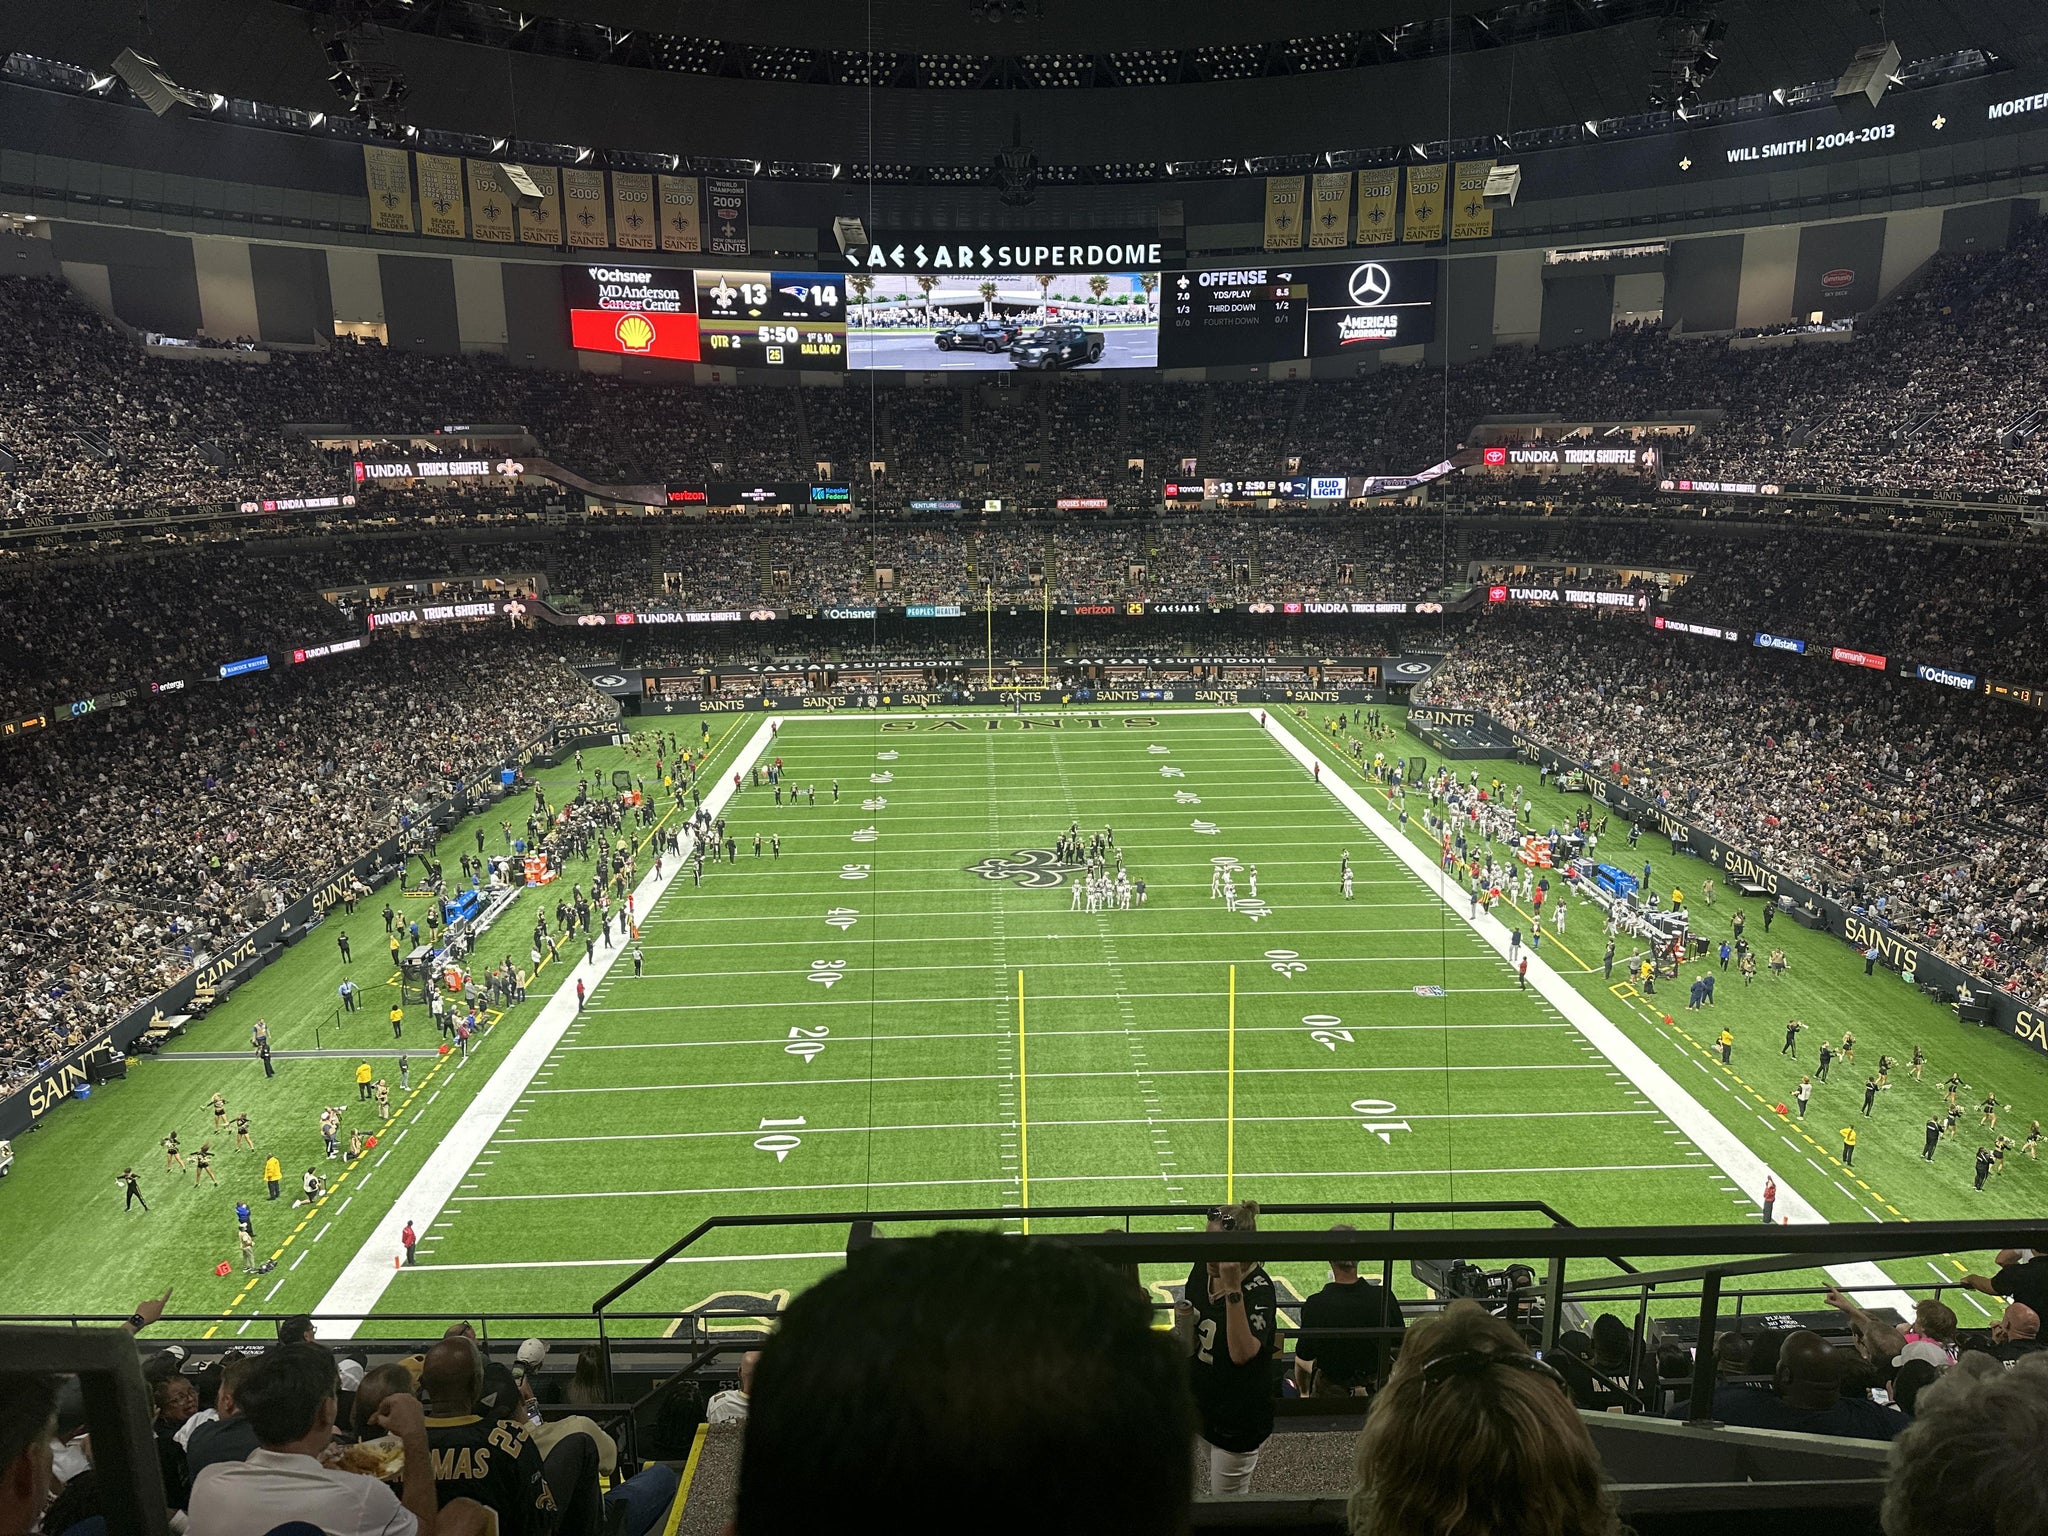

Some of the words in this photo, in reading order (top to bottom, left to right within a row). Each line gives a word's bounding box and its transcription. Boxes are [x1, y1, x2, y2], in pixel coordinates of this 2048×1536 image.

[1728, 146, 1760, 163] WILL
[1762, 138, 1807, 158] SMITH
[1816, 123, 1896, 150] 2004-2013
[709, 186, 744, 194] CHAMPIONS
[1412, 183, 1439, 194] 2019
[1460, 179, 1486, 190] 2020
[570, 188, 600, 200] 2006
[618, 190, 648, 202] 2009
[1319, 190, 1344, 201] 2017
[1365, 186, 1391, 197] 2018
[665, 193, 694, 204] 2009
[713, 196, 742, 208] 2009
[1273, 194, 1296, 204] 2011
[427, 228, 460, 236] HOLDERS
[432, 222, 455, 230] TICKET
[570, 236, 605, 246] SAINTS
[1266, 237, 1300, 247] SAINTS
[1359, 232, 1392, 242] SAINTS
[712, 243, 746, 252] SAINTS
[998, 244, 1162, 268] SUPERDOME
[597, 268, 652, 284] Ochsner
[1198, 271, 1267, 286] OFFENSE
[599, 285, 622, 297] MD
[622, 285, 680, 300] Anderson
[740, 283, 768, 305] 13
[810, 285, 838, 306] 14
[1213, 290, 1251, 300] YDS/PLAY
[598, 297, 642, 310] Cancer
[642, 298, 681, 312] Center
[1176, 306, 1190, 314] 1/3
[1208, 305, 1230, 313] THIRD
[1230, 304, 1256, 312] DOWN
[1276, 302, 1289, 310] 1/2
[1176, 319, 1190, 328] 0/0
[1204, 318, 1234, 326] FOURTH
[1234, 317, 1260, 325] DOWN
[1274, 316, 1288, 324] 0/1
[1337, 314, 1398, 330] AMERICAS
[758, 326, 798, 343] 5:50
[824, 333, 834, 343] 10
[710, 335, 730, 349] QTR
[732, 336, 741, 348] 2
[769, 349, 780, 360] 25
[801, 344, 818, 354] BALL
[819, 344, 830, 354] ON
[831, 344, 842, 354] 47
[1509, 450, 1558, 463] TUNDRA
[1565, 450, 1596, 463] TRUCK
[1596, 449, 1636, 463] SHUFFLE
[365, 464, 412, 478] TUNDRA
[416, 462, 449, 476] TRUCK
[450, 461, 489, 475] SHUFFLE
[1219, 482, 1234, 493] 13
[1245, 481, 1265, 490] 5:50
[1278, 481, 1292, 492] 14
[1318, 480, 1339, 488] BUD
[1692, 482, 1719, 491] TUNDRA
[1816, 486, 1841, 494] SAINTS
[668, 490, 705, 501] verizon
[1314, 488, 1343, 496] LIGHT
[1873, 488, 1900, 497] SAINTS
[1932, 490, 1962, 501] SAINTS
[276, 499, 305, 510] TUNDRA
[1080, 500, 1108, 508] MARKETS
[1997, 494, 2029, 505] SAINTS
[144, 508, 170, 518] SAINTS
[198, 505, 222, 514] SAINTS
[24, 517, 55, 528] SAINTS
[86, 511, 115, 522] SAINTS
[1509, 589, 1559, 601] TUNDRA
[1565, 590, 1595, 603] TRUCK
[1596, 592, 1634, 606] SHUFFLE
[373, 610, 417, 626] TUNDRA
[423, 606, 454, 620] TRUCK
[454, 603, 496, 618] SHUFFLE
[830, 609, 876, 619] Ochsner
[907, 608, 935, 616] PEOPLES
[1074, 605, 1115, 614] verizon
[1129, 604, 1142, 613] 25
[1154, 605, 1200, 613] CAESARS
[1304, 604, 1348, 613] TUNDRA
[1352, 604, 1375, 612] TRUCK
[1376, 604, 1406, 612] SHUFFLE
[637, 613, 683, 624] TUNDRA
[686, 612, 710, 622] TRUCK
[711, 611, 741, 622] SHUFFLE
[1665, 620, 1688, 632] TUNDRA
[1772, 637, 1799, 651] Allstate
[1808, 644, 1832, 656] SAINTS
[305, 646, 330, 659] TUNDRA
[1834, 648, 1866, 664] Community
[748, 663, 849, 673] CAESARS
[853, 660, 964, 669] SUPERDOME
[1064, 658, 1162, 666] CAESARS
[1165, 657, 1277, 666] SUPERDOME
[1926, 667, 1974, 689] Ochsner
[160, 679, 184, 692] entergy
[111, 688, 138, 702] SAINTS
[902, 693, 945, 704] SAINTS
[1096, 691, 1139, 701] SAINTS
[1194, 691, 1238, 701] SAINTS
[1295, 691, 1339, 702] SAINTS
[71, 698, 96, 716] COX
[700, 700, 744, 712] SAINTS
[802, 697, 846, 708] SAINTS
[40, 716, 46, 728] 3
[1414, 709, 1475, 727] SAINTS
[4, 723, 14, 734] 14
[880, 717, 1160, 733] SAINTS
[839, 864, 870, 880] 50
[1724, 850, 1778, 895] SAINTS
[312, 869, 355, 916] SAINTS
[1234, 898, 1273, 916] 40
[825, 906, 859, 926] 40
[1845, 917, 1918, 973] SAINTS
[196, 938, 257, 990] SAINTS
[1264, 949, 1308, 973] 30
[807, 959, 847, 988] 30
[1302, 1014, 1356, 1045] 20
[784, 1024, 829, 1056] 20
[1350, 1100, 1413, 1136] 10
[754, 1114, 807, 1153] 10
[488, 1418, 528, 1460] 23
[431, 1448, 491, 1481] MAS
